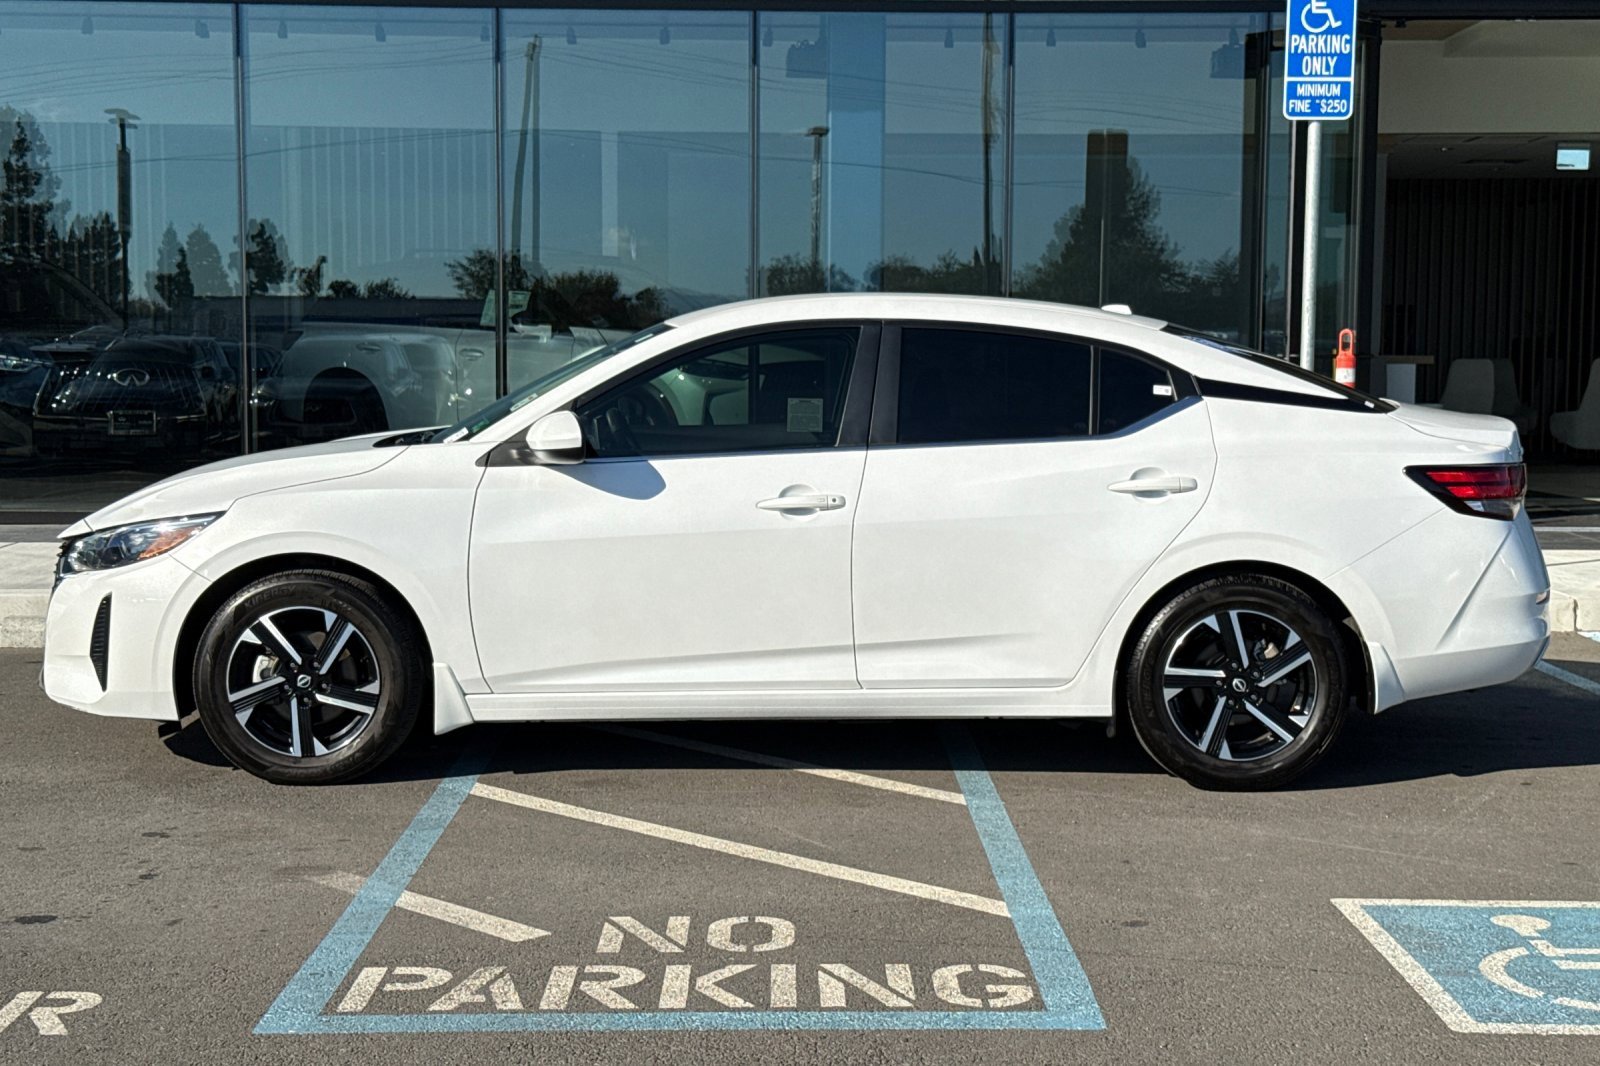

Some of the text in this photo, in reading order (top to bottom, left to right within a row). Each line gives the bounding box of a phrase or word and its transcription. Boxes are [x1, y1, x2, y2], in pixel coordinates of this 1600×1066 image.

[1290, 34, 1351, 54] PARKING
[1301, 55, 1338, 76] ONLY
[1296, 83, 1341, 97] MINIMUM
[1288, 99, 1347, 114] FINE $250
[595, 915, 797, 954] NO
[335, 962, 1035, 1013] PARKING
